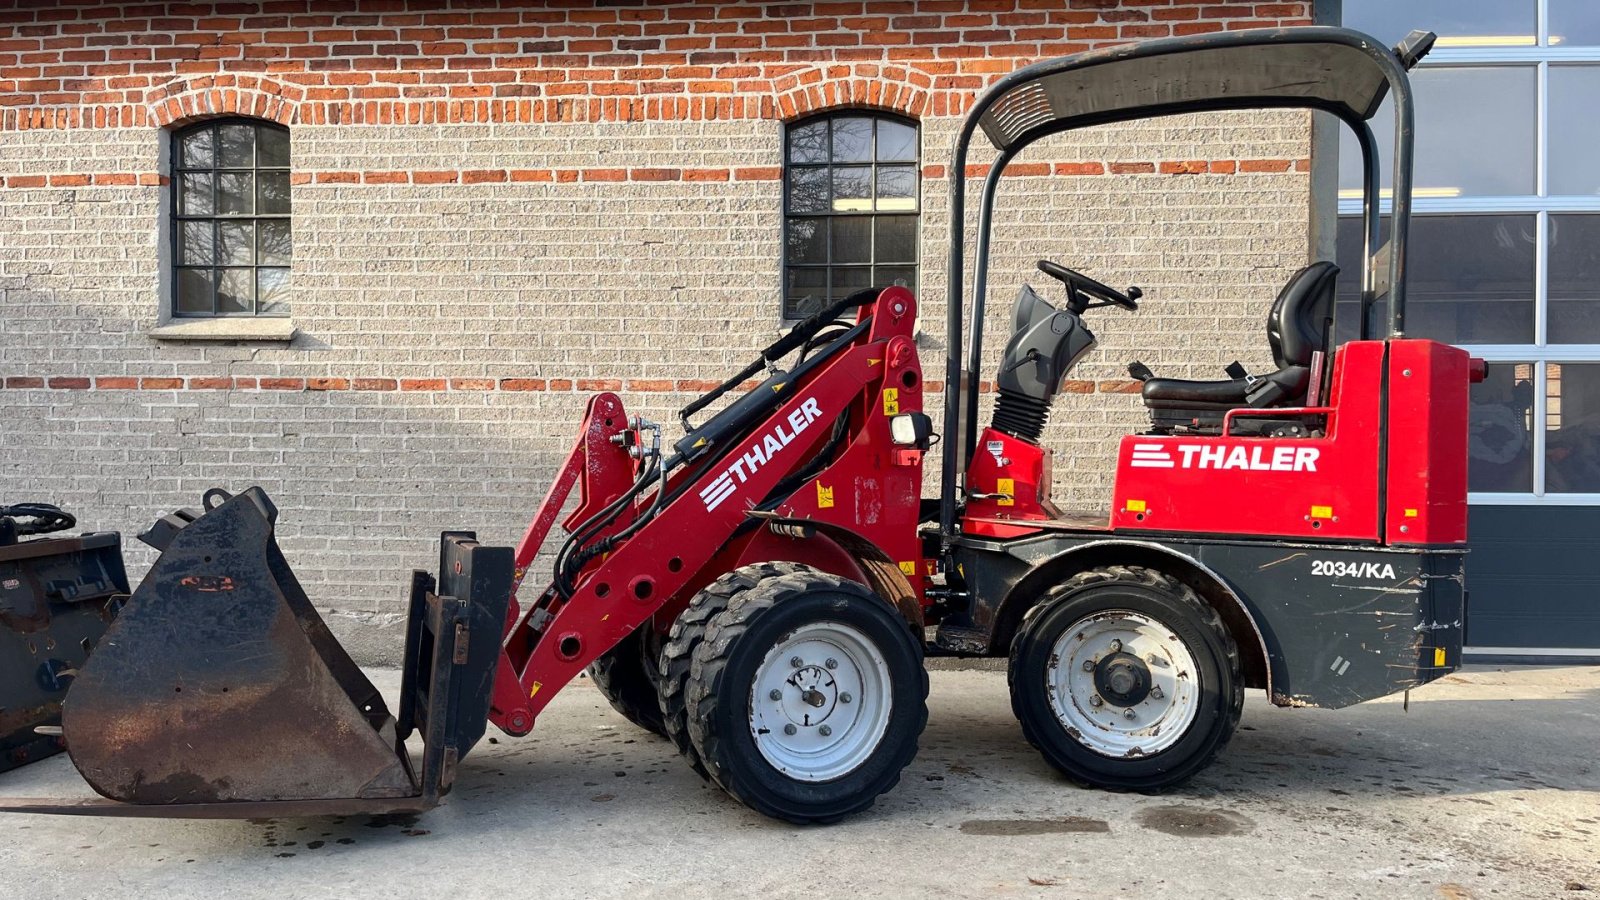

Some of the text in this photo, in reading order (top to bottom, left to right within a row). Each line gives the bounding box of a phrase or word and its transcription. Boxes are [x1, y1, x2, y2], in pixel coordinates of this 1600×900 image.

[728, 397, 823, 483] THALER
[1178, 445, 1320, 472] THALER
[1311, 560, 1396, 579] 2034/KA
